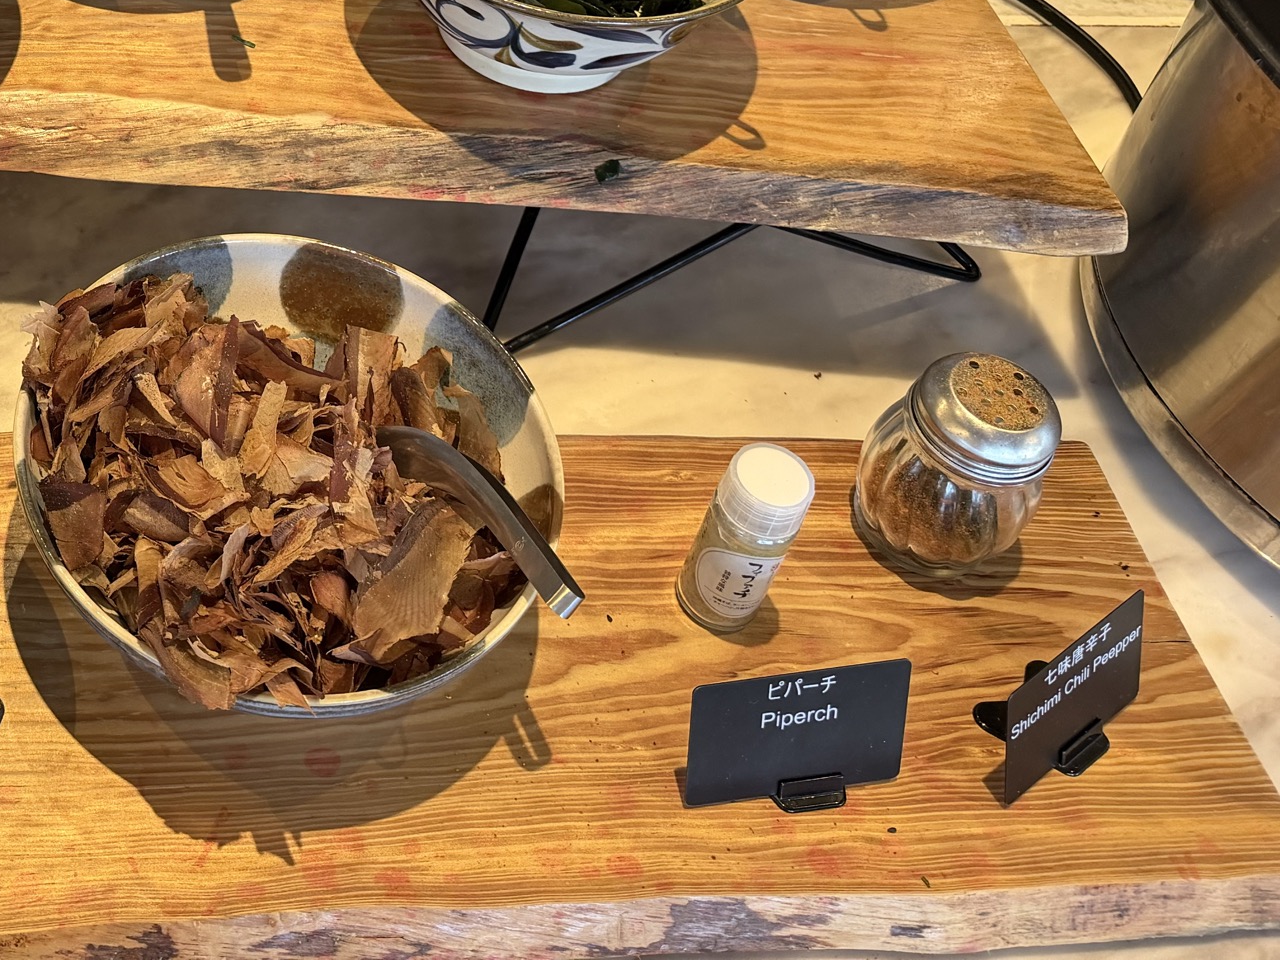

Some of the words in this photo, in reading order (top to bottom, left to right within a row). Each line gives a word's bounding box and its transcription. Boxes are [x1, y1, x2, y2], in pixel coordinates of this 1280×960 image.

[1044, 622, 1112, 686] 七味唐辛子
[767, 675, 837, 701] ピパーチ
[1010, 689, 1061, 740] Shichimi
[1064, 665, 1090, 695] Chili
[1093, 625, 1142, 673] Peepper
[760, 704, 839, 730] Piperch
